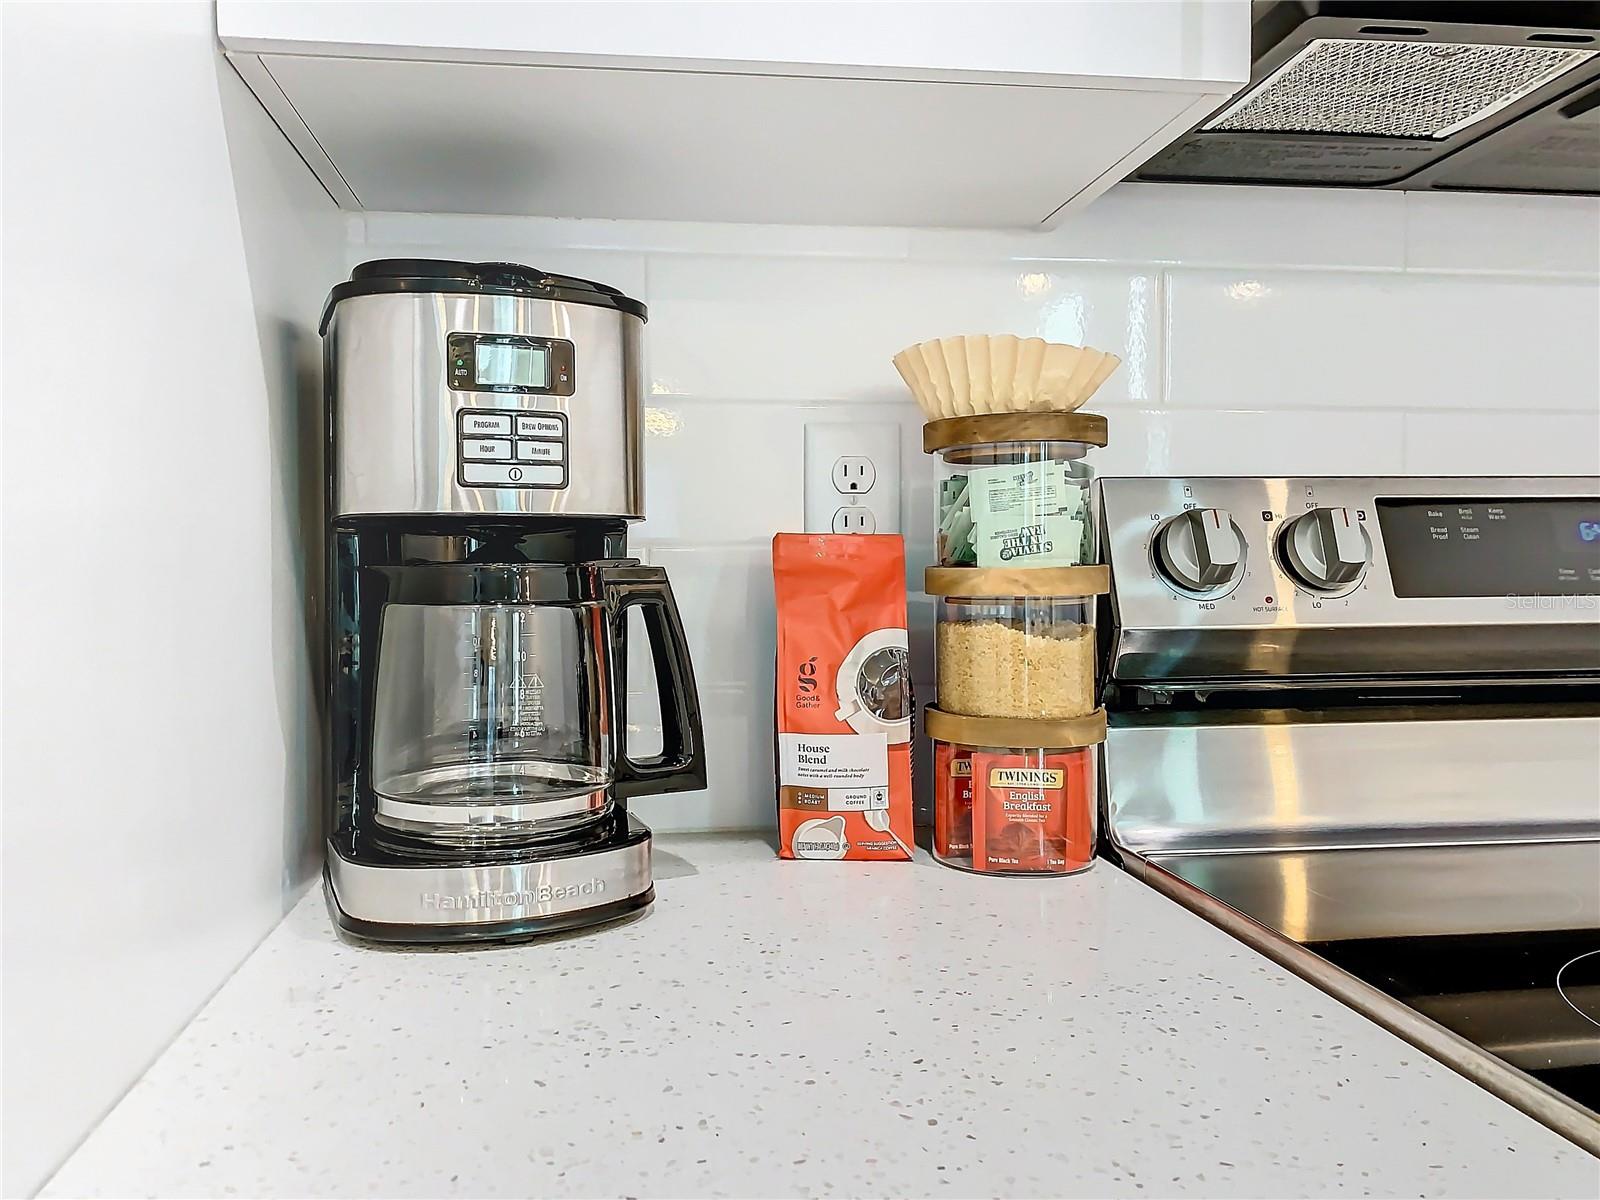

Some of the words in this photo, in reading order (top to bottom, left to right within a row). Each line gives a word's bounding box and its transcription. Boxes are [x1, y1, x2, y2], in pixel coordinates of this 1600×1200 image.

[473, 420, 501, 429] PROGRAM
[521, 422, 537, 431] BREW
[479, 444, 496, 453] HOUR
[1150, 513, 1160, 521] LO
[1011, 541, 1053, 558] STEVIA
[1312, 601, 1322, 609] LO
[795, 701, 821, 709] Gather
[797, 743, 831, 753] House
[797, 754, 828, 765] Blend
[997, 770, 1058, 784] TWININGS
[1009, 791, 1046, 803] English
[1003, 801, 1052, 812] Breakfast
[988, 856, 998, 864] Pure
